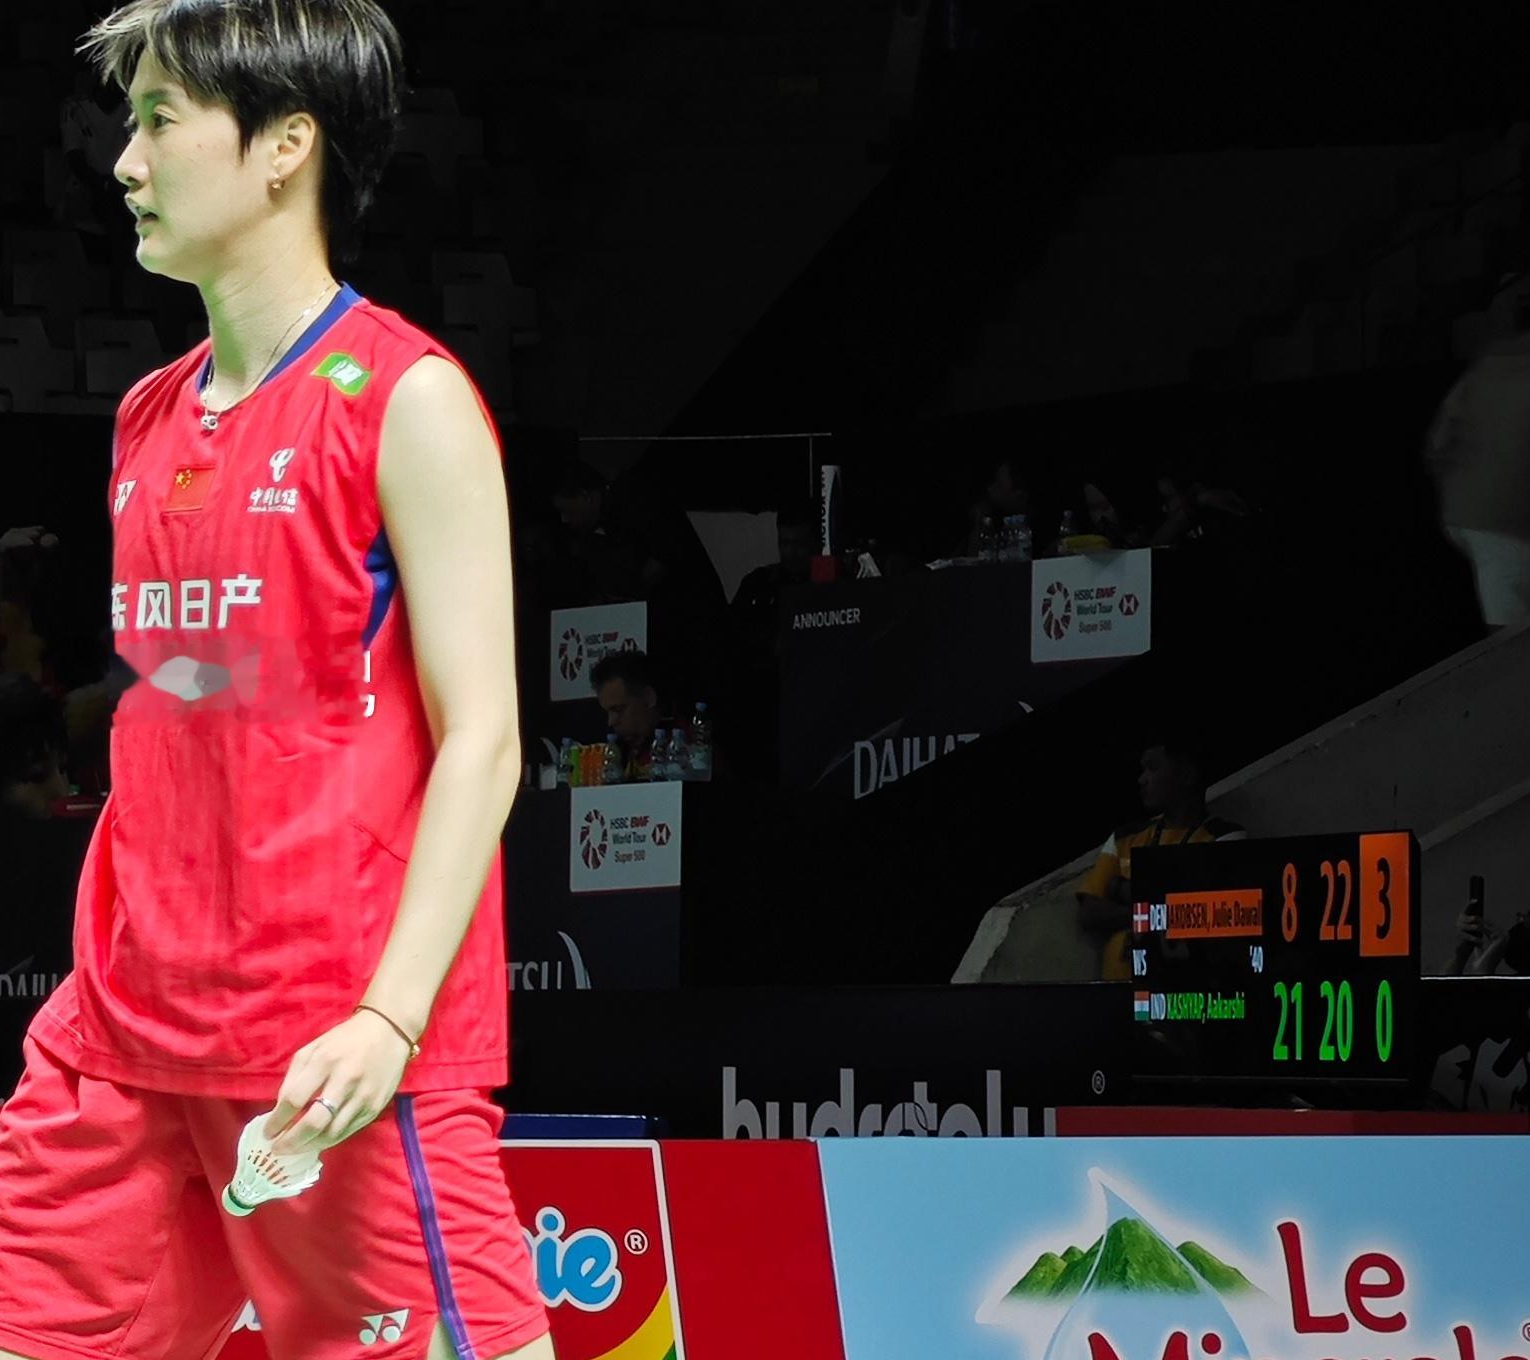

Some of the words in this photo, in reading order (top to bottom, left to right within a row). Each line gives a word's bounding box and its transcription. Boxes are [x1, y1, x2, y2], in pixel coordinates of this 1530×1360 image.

[792, 607, 861, 631] ANNOUNCER
[1150, 903, 1167, 931] DEN
[1281, 862, 1298, 942] 8
[1320, 859, 1352, 940] 22
[1376, 857, 1392, 939] 3
[1150, 993, 1167, 1020] IND
[1273, 982, 1302, 1061] 21
[1319, 980, 1354, 1062] 20
[1376, 980, 1393, 1063] 0
[1277, 1220, 1407, 1334] Le
